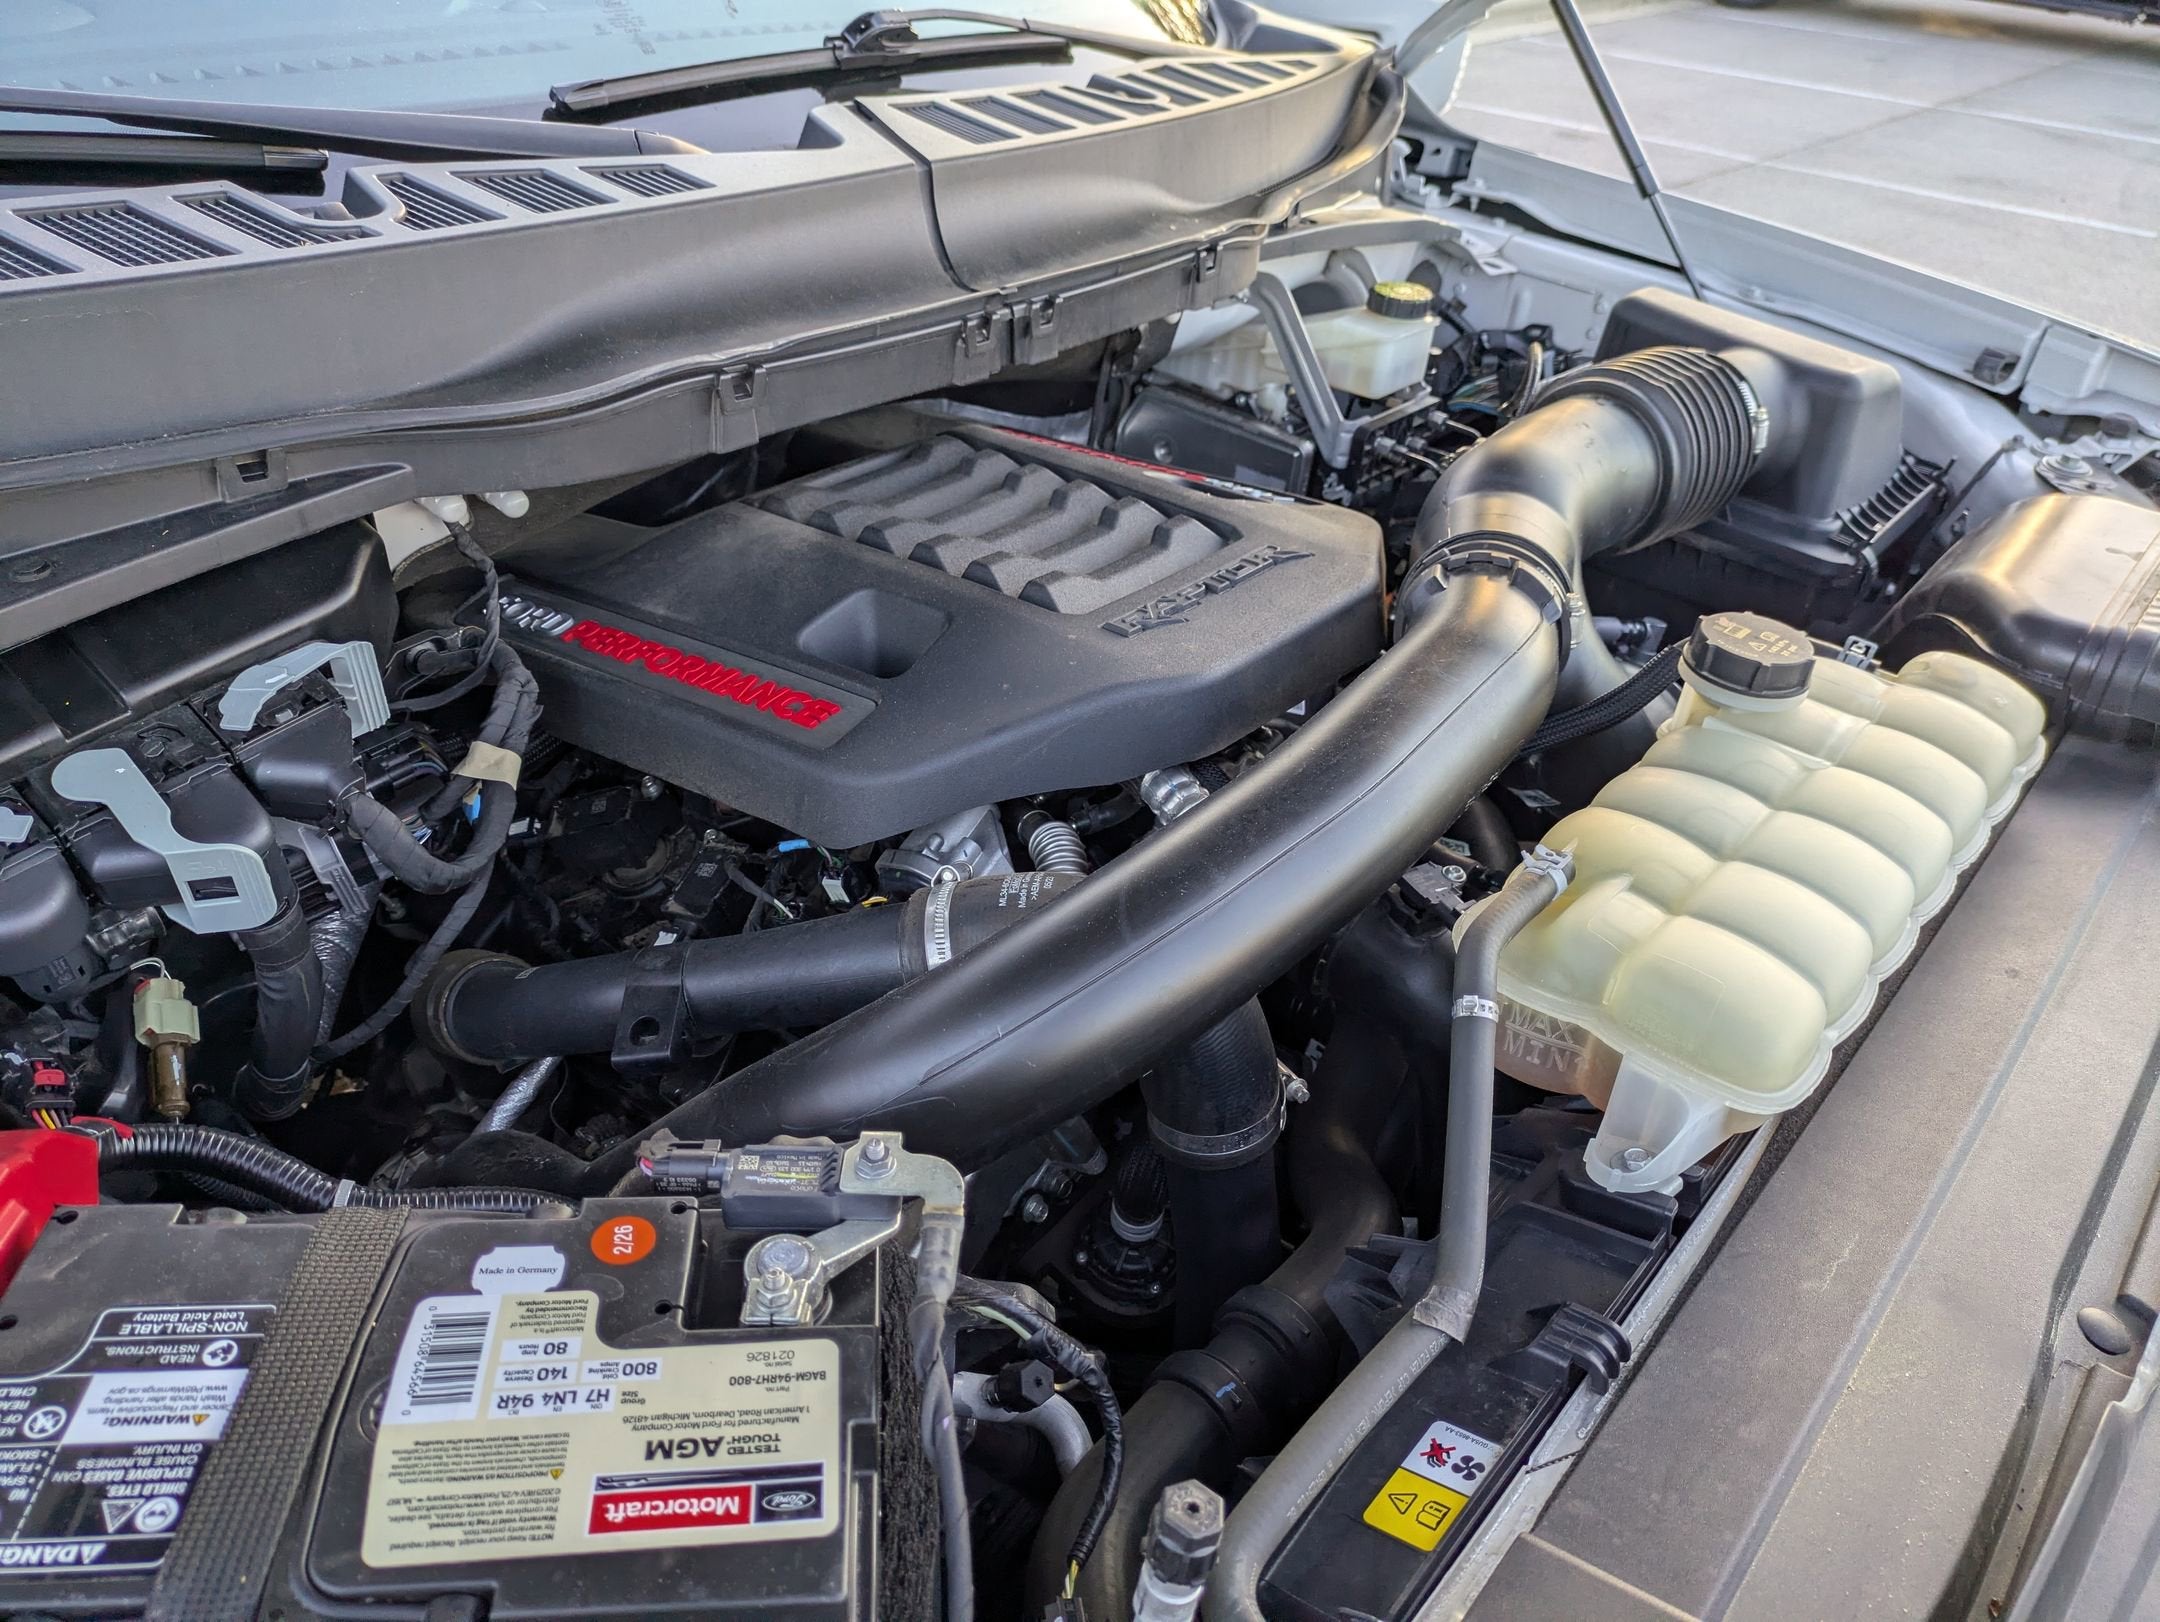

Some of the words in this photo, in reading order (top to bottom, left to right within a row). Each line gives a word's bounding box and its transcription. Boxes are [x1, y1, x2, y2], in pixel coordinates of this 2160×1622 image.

[1098, 544, 1316, 638] RAPTOR
[560, 619, 842, 730] PERFORMANCE
[1018, 888, 1027, 908] Made
[1511, 1002, 1576, 1044] MAX
[1504, 1028, 1570, 1072] MIN
[612, 1224, 634, 1255] 2/26
[478, 1266, 504, 1276] Made
[506, 1266, 515, 1275] in
[517, 1266, 559, 1278] Germany
[133, 1312, 179, 1322] Battery
[181, 1312, 211, 1321] Acid
[213, 1311, 244, 1321] Lead
[119, 1321, 248, 1335] NON-SPILLABLE
[105, 1344, 200, 1356] INSTRUCTIONS.
[518, 1343, 539, 1351] Hours
[521, 1349, 538, 1357] Amp
[543, 1341, 568, 1355] 80
[160, 1354, 196, 1363] READ
[746, 1350, 795, 1362] 021826
[503, 1369, 535, 1377] Capacity
[537, 1366, 568, 1381] 140
[588, 1367, 620, 1375] Cranking
[622, 1361, 658, 1376] 800
[729, 1370, 827, 1386] BAGM-94RH7-800
[541, 1390, 577, 1407] LN4
[585, 1388, 610, 1403] H7
[621, 1390, 639, 1398] Size
[496, 1394, 534, 1409] 94R
[650, 1412, 690, 1423] Michigan
[692, 1409, 735, 1421] Dearborn,
[736, 1408, 762, 1419] Road,
[763, 1406, 805, 1417] American
[102, 1414, 191, 1426] WARNING:
[622, 1415, 649, 1424] 48126
[674, 1421, 700, 1430] Motor
[702, 1420, 722, 1429] Ford
[724, 1420, 736, 1428] for
[738, 1415, 800, 1427] Manufactured
[631, 1421, 673, 1432] Company
[133, 1444, 181, 1455] INJURY.
[183, 1443, 203, 1453] OR
[644, 1436, 725, 1461] AGM
[727, 1443, 781, 1455] TESTED
[76, 1456, 152, 1469] BLINDNESS
[154, 1454, 198, 1466] CAUSE
[52, 1471, 82, 1482] CAN
[82, 1470, 125, 1483] GASES
[125, 1466, 194, 1481] EXPLOSIVE
[106, 1484, 141, 1497] EYES.
[141, 1481, 188, 1495] SHIELD
[772, 1493, 808, 1508] Ford
[605, 1495, 740, 1523] Motorcraft
